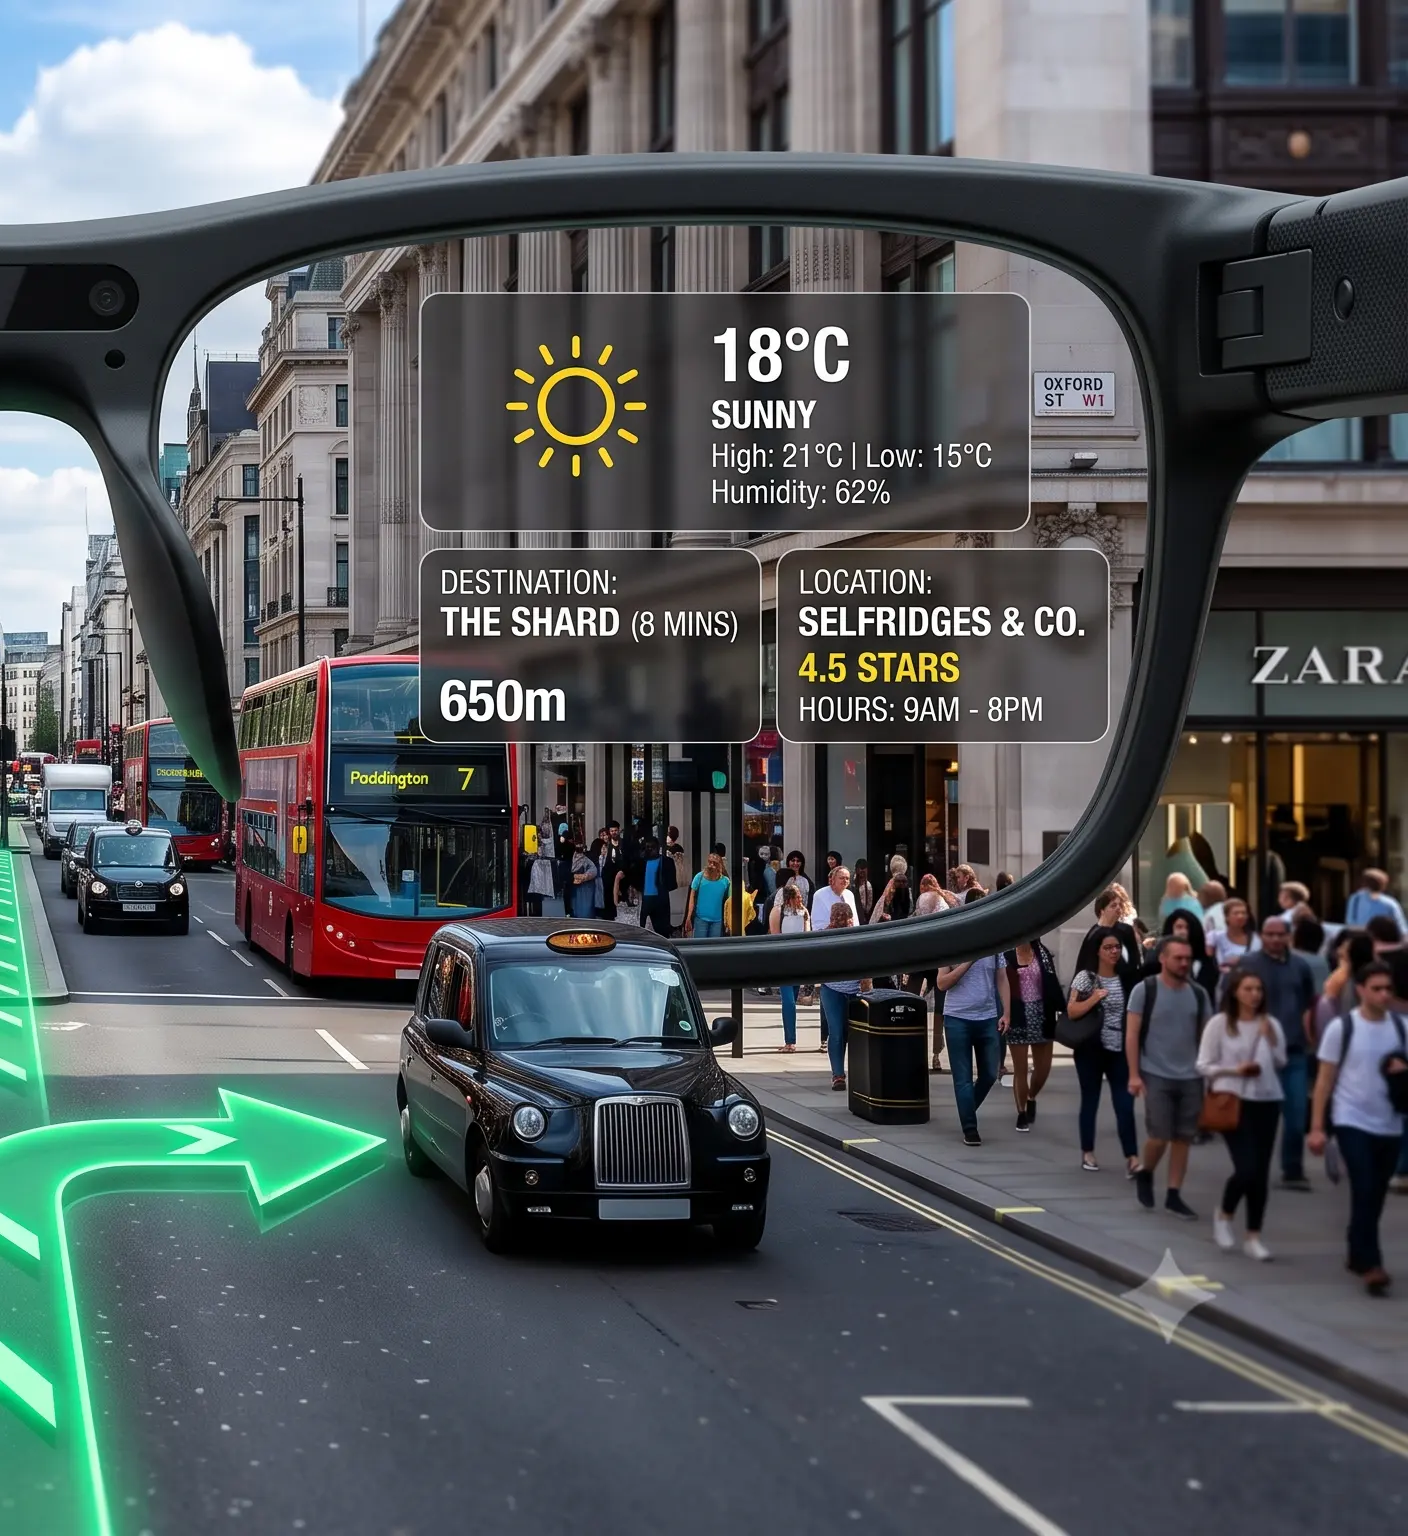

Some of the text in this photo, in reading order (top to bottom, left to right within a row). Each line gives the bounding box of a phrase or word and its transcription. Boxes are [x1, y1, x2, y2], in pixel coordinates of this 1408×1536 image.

[713, 326, 850, 384] 18°C
[1043, 377, 1104, 391] OXFORD
[1044, 393, 1104, 407] ST W1
[711, 399, 818, 431] SUNNY
[712, 442, 775, 475] High:
[782, 442, 844, 469] 21°C
[866, 442, 924, 469] Low:
[932, 442, 993, 469] 15°C
[711, 478, 892, 511] Humidity: 62%
[440, 568, 618, 596] DESTINATION:
[799, 568, 933, 596] LOCATION:
[440, 606, 739, 644] THE SHARD (8 MINS)
[798, 606, 1086, 638] SELFRIDGES & CO.
[798, 651, 961, 684] 4.5 STARS
[440, 679, 567, 723] 650m
[799, 695, 896, 723] HOURS:
[903, 695, 960, 723] 9AM
[987, 695, 1044, 723] 8PM
[350, 767, 476, 791] Paddington 7
